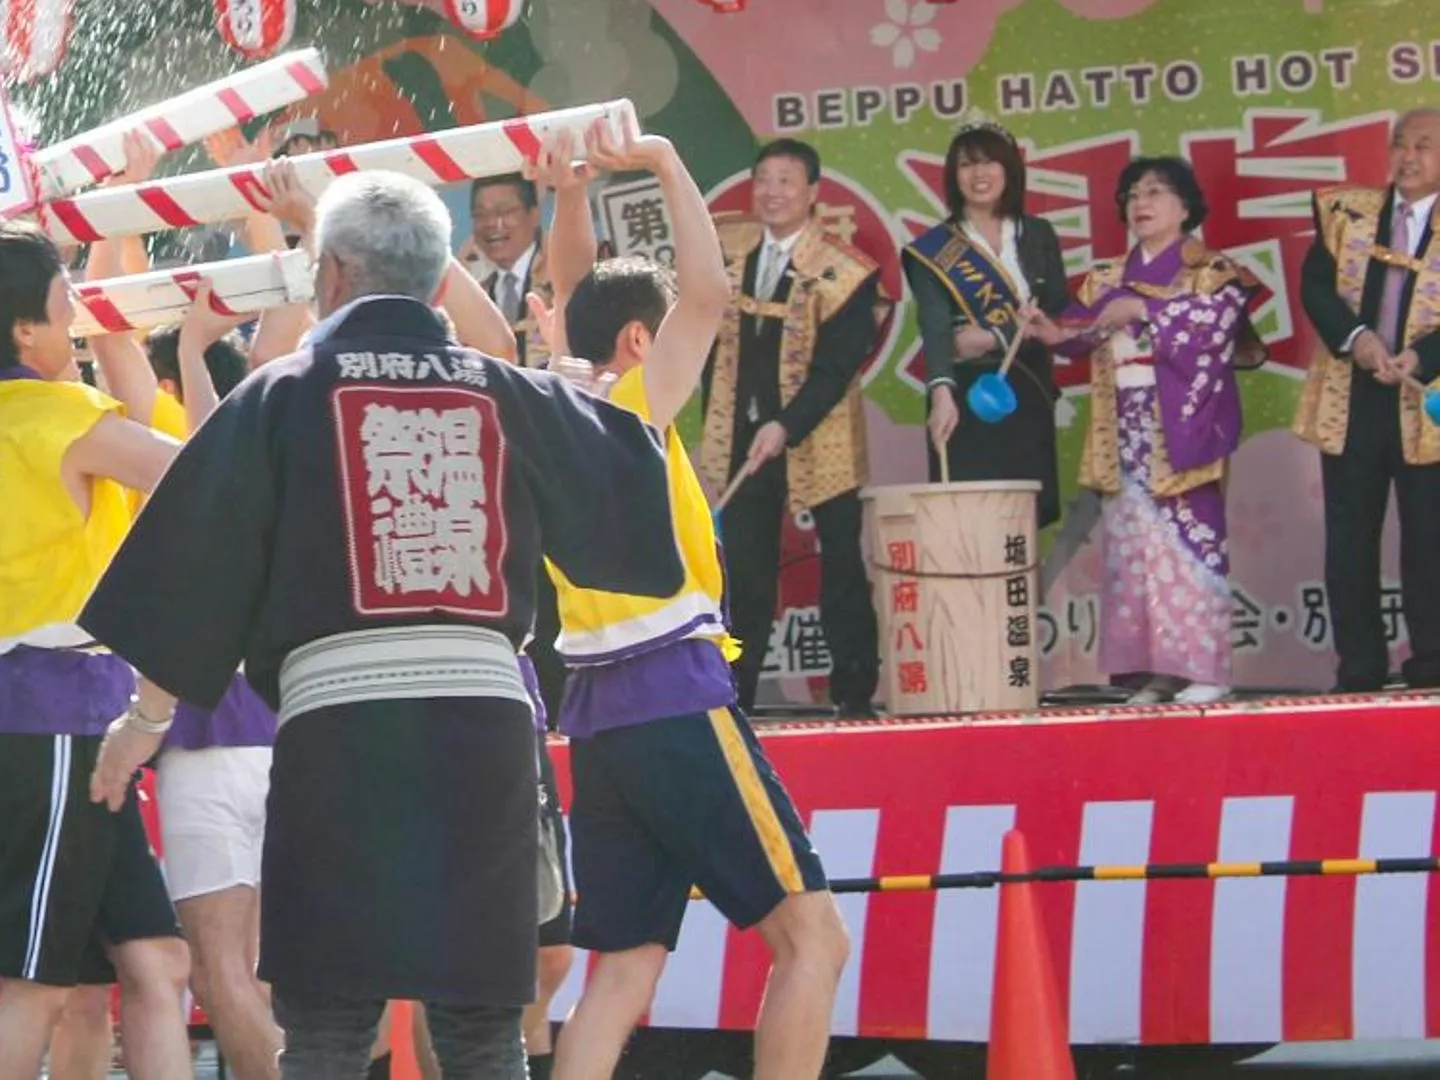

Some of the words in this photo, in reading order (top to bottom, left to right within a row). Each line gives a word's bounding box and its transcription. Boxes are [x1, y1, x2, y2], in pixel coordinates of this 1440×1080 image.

[775, 83, 963, 129] BEPPU
[1000, 62, 1200, 112] HATTO
[1235, 51, 1355, 93] HOT
[335, 350, 488, 389] 別府八湯
[886, 539, 928, 695] 別府八湯
